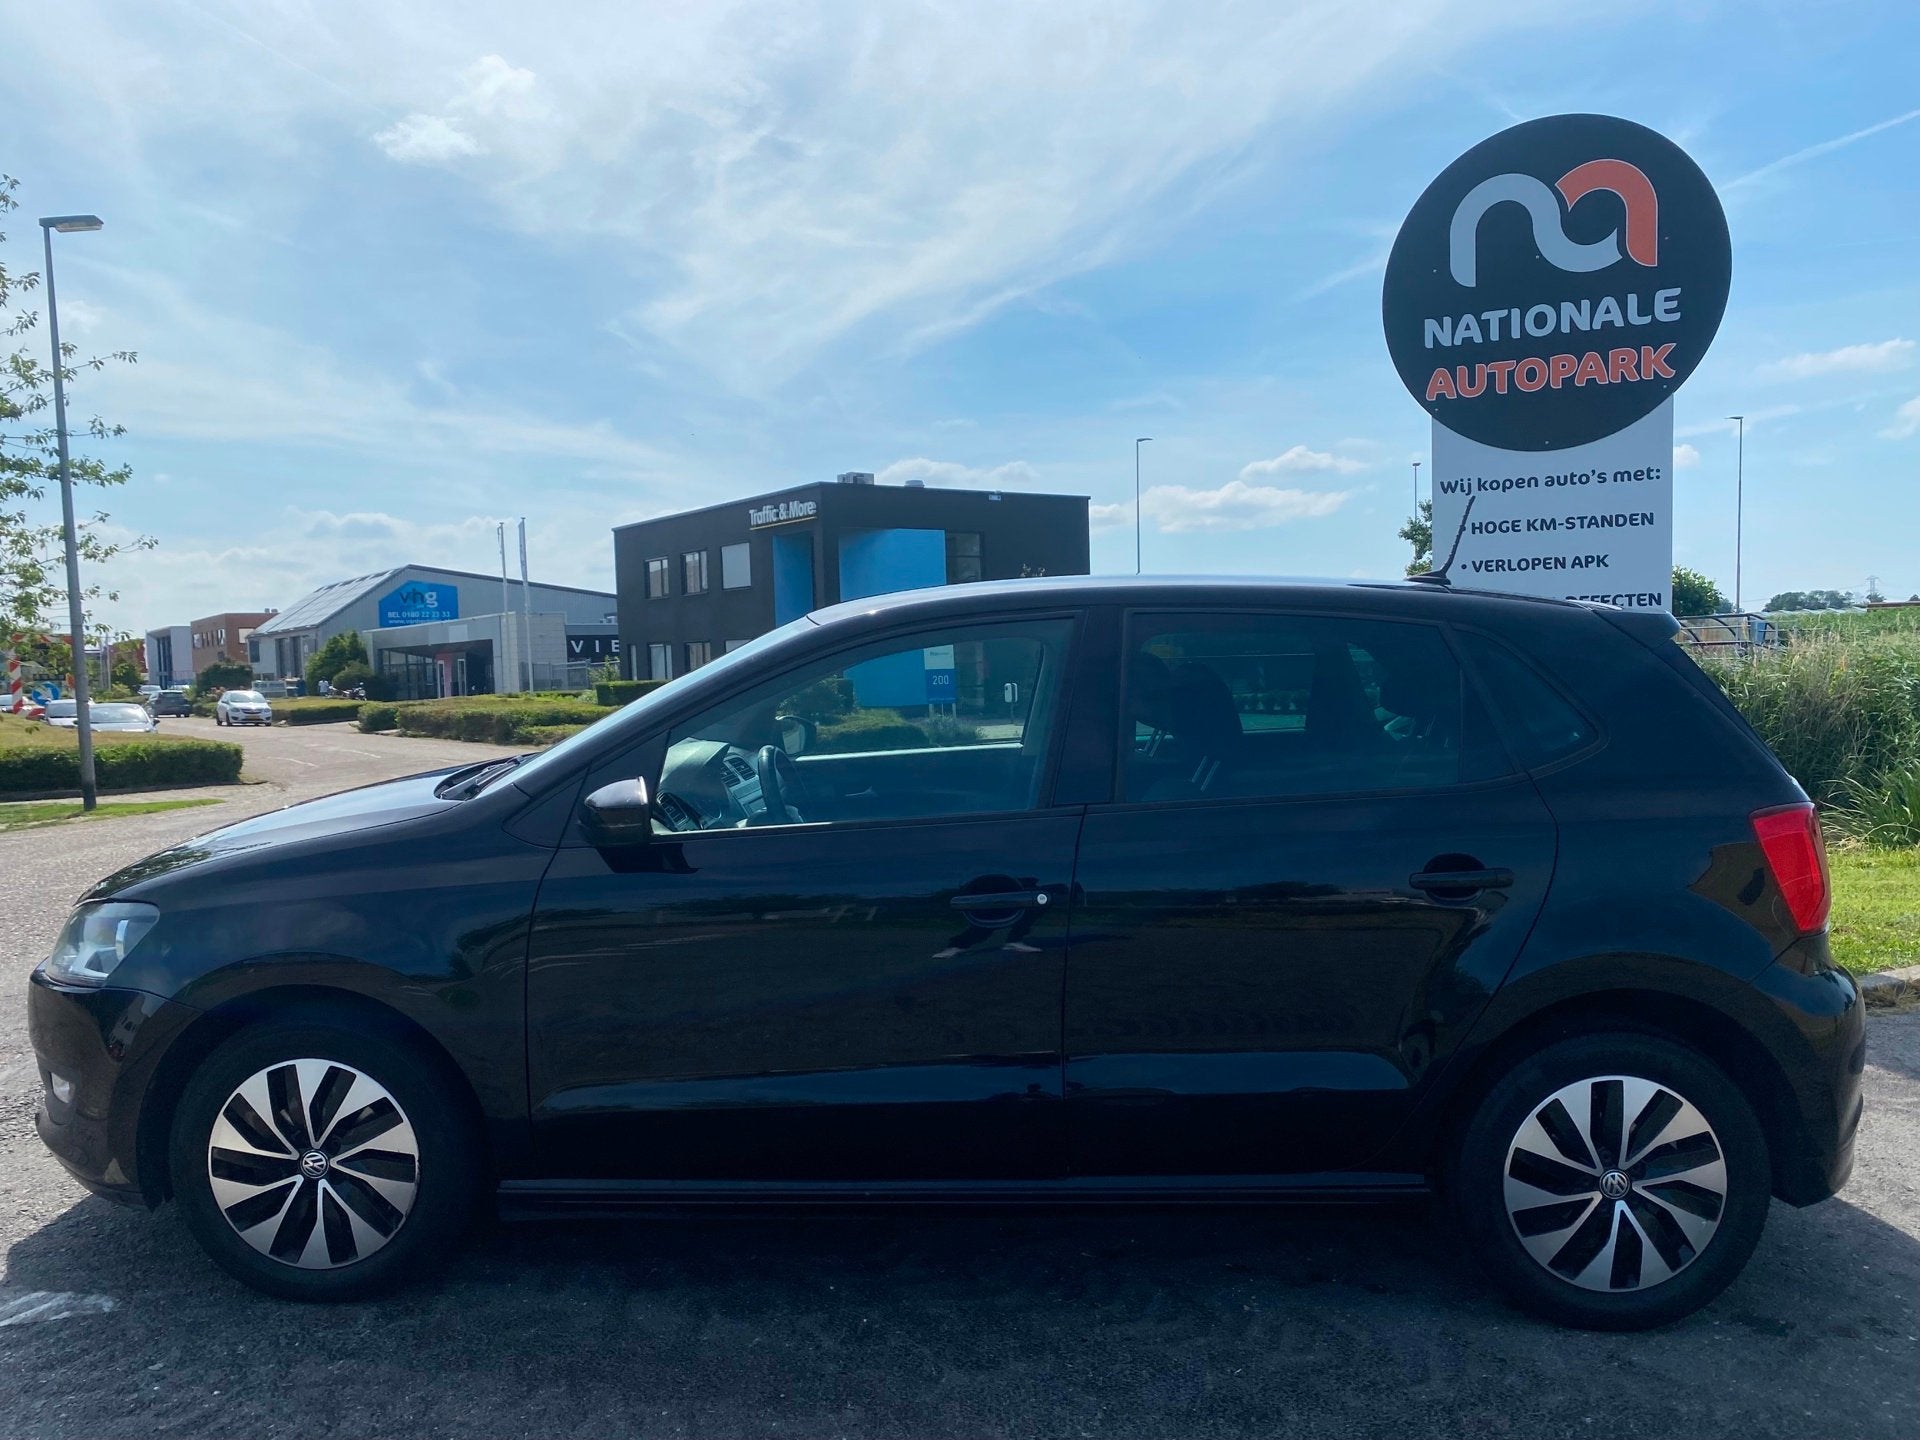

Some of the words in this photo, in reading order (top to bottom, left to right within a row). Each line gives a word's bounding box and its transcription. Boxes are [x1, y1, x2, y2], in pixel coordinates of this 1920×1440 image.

[1424, 287, 1682, 349] NATIONALE
[1425, 342, 1678, 401] AUTOPARK
[1440, 478, 1472, 496] Wij
[1477, 476, 1539, 493] kopen
[1544, 469, 1608, 488] auto's
[1613, 466, 1661, 483] met:
[749, 504, 778, 526] Traffic
[778, 502, 788, 520] &
[789, 500, 817, 519] More
[1471, 519, 1522, 535] HOGE
[1526, 512, 1654, 532] KM-STANDEN
[1471, 556, 1567, 573] VERLOPEN
[1571, 554, 1610, 569] APK
[400, 587, 438, 609] vhg
[932, 674, 949, 685] 200
